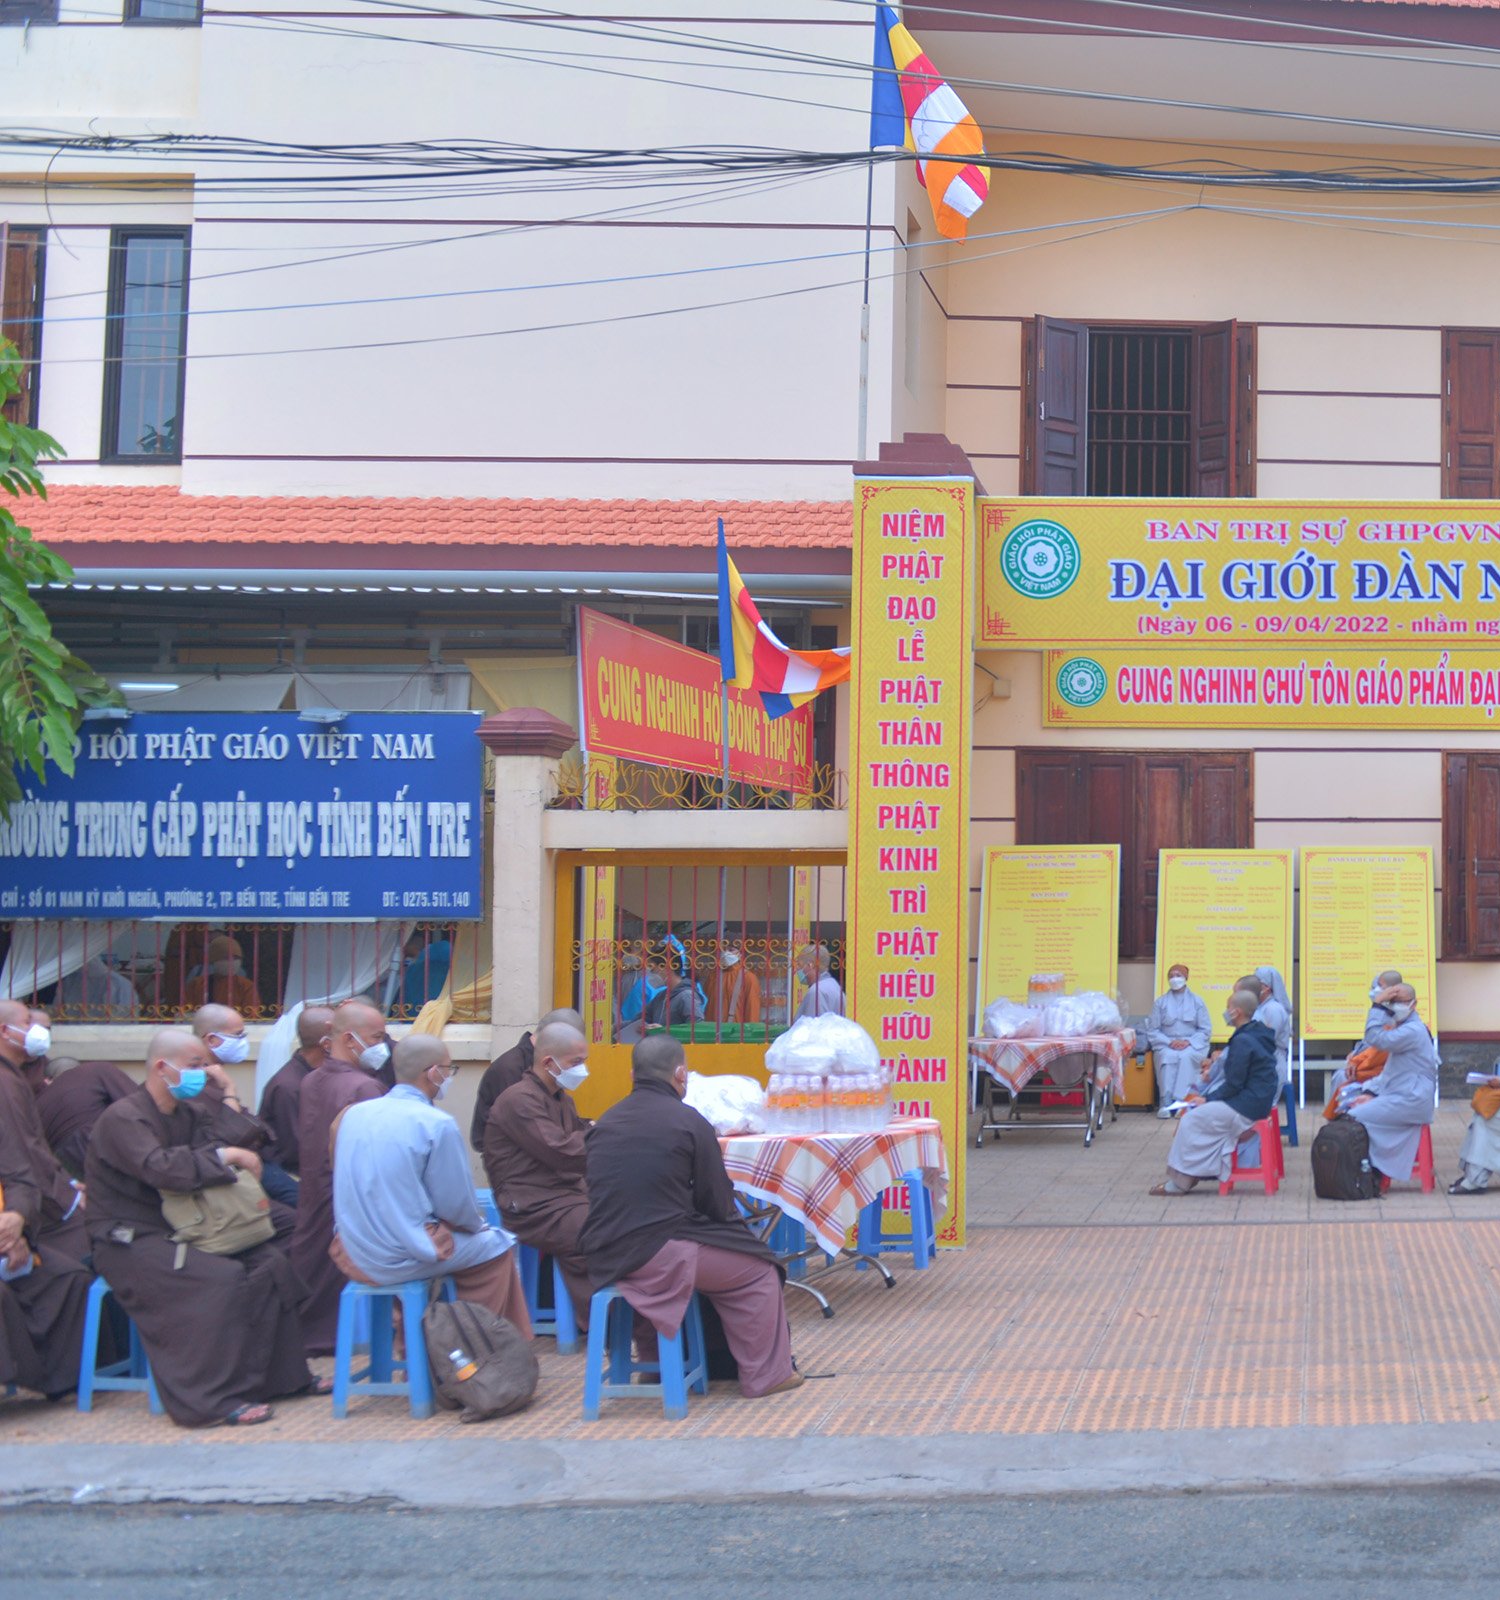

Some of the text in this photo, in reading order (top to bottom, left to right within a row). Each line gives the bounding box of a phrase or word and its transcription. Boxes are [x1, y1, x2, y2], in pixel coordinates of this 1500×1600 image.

[882, 510, 945, 541] NIỆM
[1148, 521, 1219, 542] BAN
[1231, 522, 1288, 546] TRỊ
[1302, 518, 1347, 546] SỰ
[882, 551, 944, 583] PHẬT
[1109, 561, 1205, 609] ĐẠI
[1221, 549, 1338, 602] GIỚI
[1353, 551, 1461, 602] ĐÀN
[888, 597, 936, 625] ĐẠO
[1137, 615, 1197, 635] (Ngày
[1205, 616, 1233, 633] 06
[1255, 615, 1389, 635] 09/04/2022
[898, 630, 924, 662] LỄ
[880, 675, 942, 708] PHẬT
[1117, 667, 1173, 704] CUNG
[1179, 668, 1257, 704] NGHINH
[1263, 662, 1307, 705] CHƯ
[1309, 661, 1350, 705] TÔN
[1356, 660, 1403, 705] GIÁO
[1409, 652, 1465, 706] PHẨM
[598, 656, 642, 726] CUNG
[645, 671, 700, 739] NGHINH
[879, 716, 941, 745] THÂN
[89, 727, 137, 767] HỘI
[145, 727, 216, 766] PHẬT
[222, 726, 289, 760] GIÁO
[297, 727, 363, 766] VIỆT
[371, 733, 435, 760] NAM
[870, 758, 949, 788] THÔNG
[75, 801, 147, 858] TRUNG
[152, 783, 197, 858] CẤP
[202, 790, 262, 868] PHẬT
[267, 801, 313, 869] HỌC
[318, 787, 372, 858] TỈNH
[377, 784, 422, 858] BẾN
[427, 802, 471, 858] TRE
[878, 800, 940, 834] PHẬT
[880, 848, 937, 871] KINH
[29, 887, 43, 907] SỐ
[45, 891, 56, 907] 01
[60, 891, 83, 907] NAM
[220, 891, 234, 907] TP.
[237, 886, 256, 907] BẾN
[259, 891, 281, 909] TRE,
[284, 886, 306, 907] TỈNH
[309, 886, 329, 907] BẾN
[332, 891, 350, 907] TRE
[403, 891, 470, 907] 0275.511.140
[890, 885, 926, 913] TRÌ
[876, 927, 939, 960] PHẬT
[880, 969, 934, 1003] HIỆU
[882, 1012, 931, 1040] HỮU
